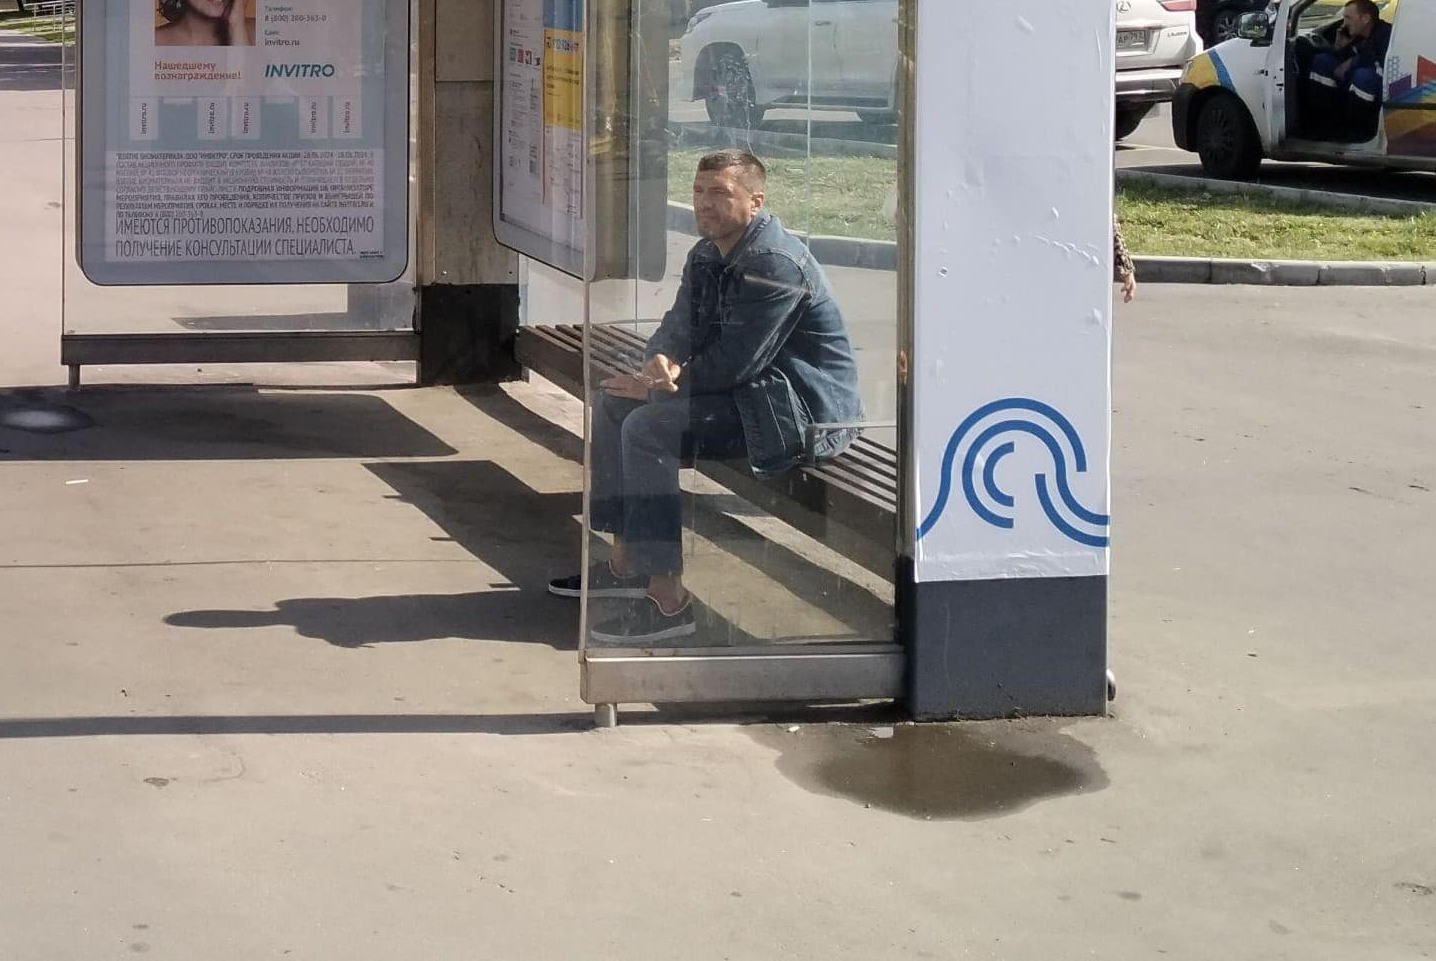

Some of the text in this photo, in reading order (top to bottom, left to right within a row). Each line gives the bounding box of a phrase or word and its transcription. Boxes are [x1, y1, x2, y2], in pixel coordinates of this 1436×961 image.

[154, 61, 216, 72] Нашедшему
[265, 64, 335, 77] INVITRO
[154, 72, 242, 81] вознаграждение!
[116, 217, 170, 235] ИМЕЮТСЯ
[297, 216, 374, 234] НЕОБХОДИМО
[116, 238, 356, 258] ПОЛУЧЕНИЕ КОНСУЛЬТАЦИИ СПЕЦИАЛИСТА.
